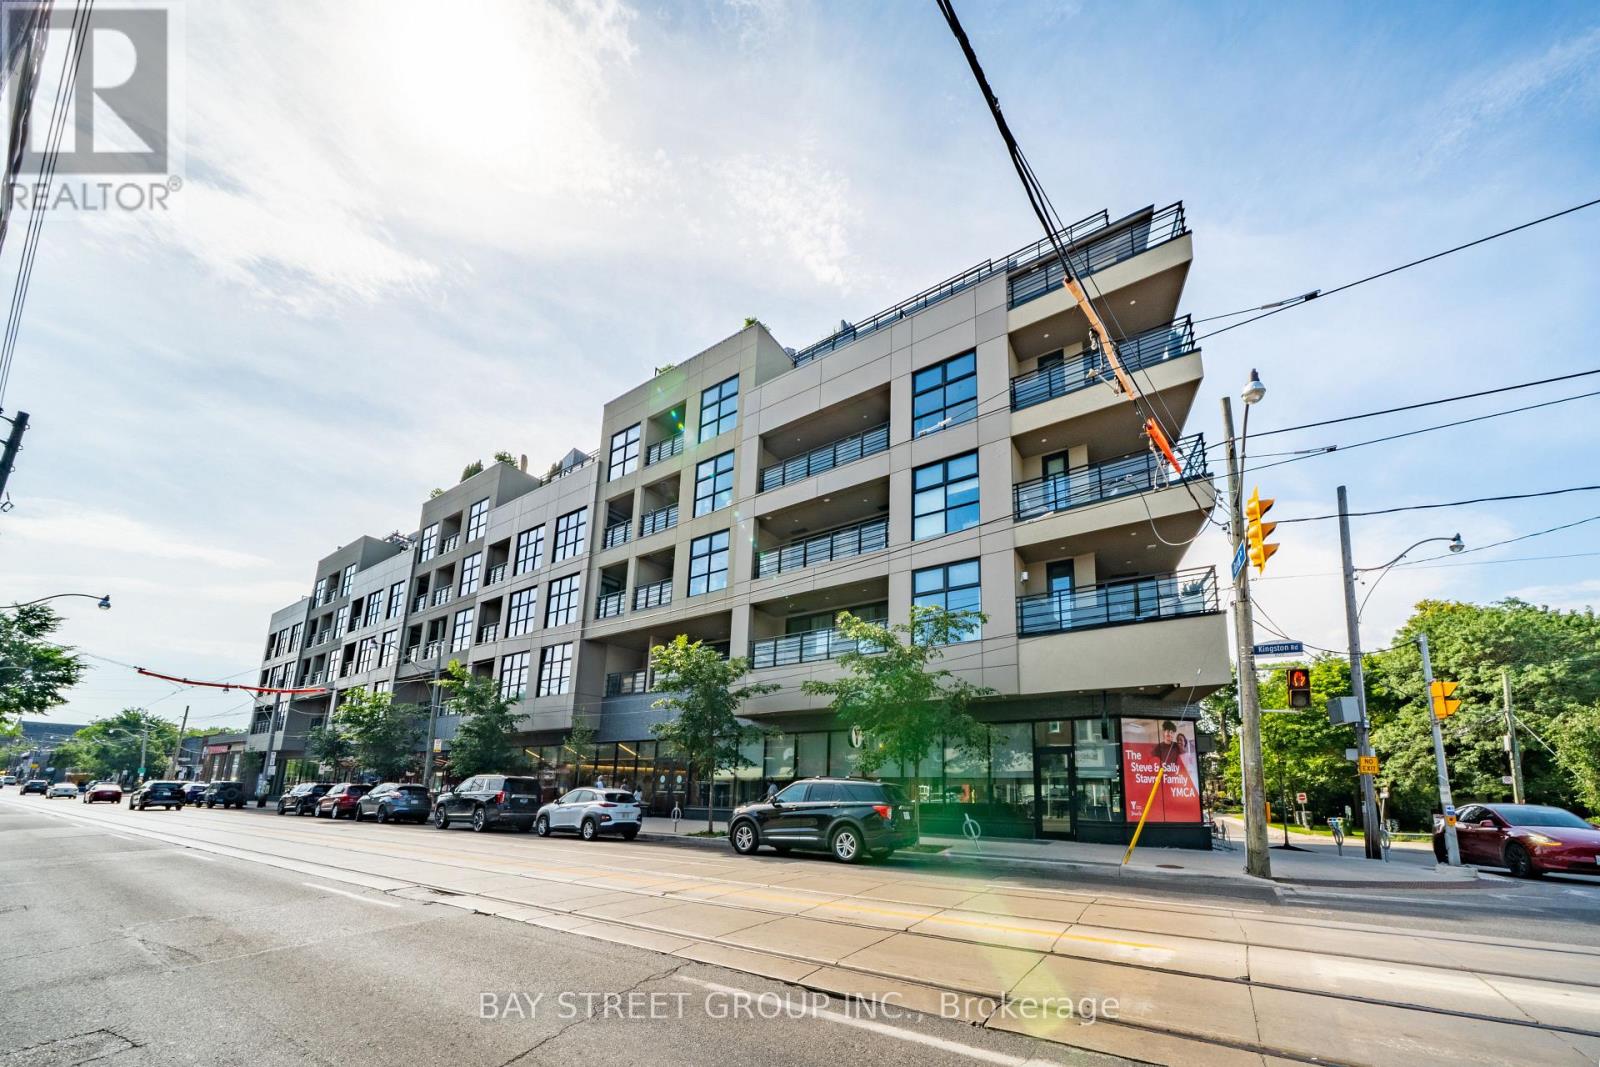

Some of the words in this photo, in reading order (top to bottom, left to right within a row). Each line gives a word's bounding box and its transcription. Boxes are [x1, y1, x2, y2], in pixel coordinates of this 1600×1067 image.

[1258, 644, 1289, 653] Kingston
[1125, 750, 1142, 760] The
[1131, 762, 1153, 772] Steve
[1153, 763, 1160, 772] &
[1161, 762, 1180, 775] Sally
[1135, 774, 1160, 784] Stavr
[1163, 774, 1188, 787] Family
[1170, 787, 1196, 798] YMCA
